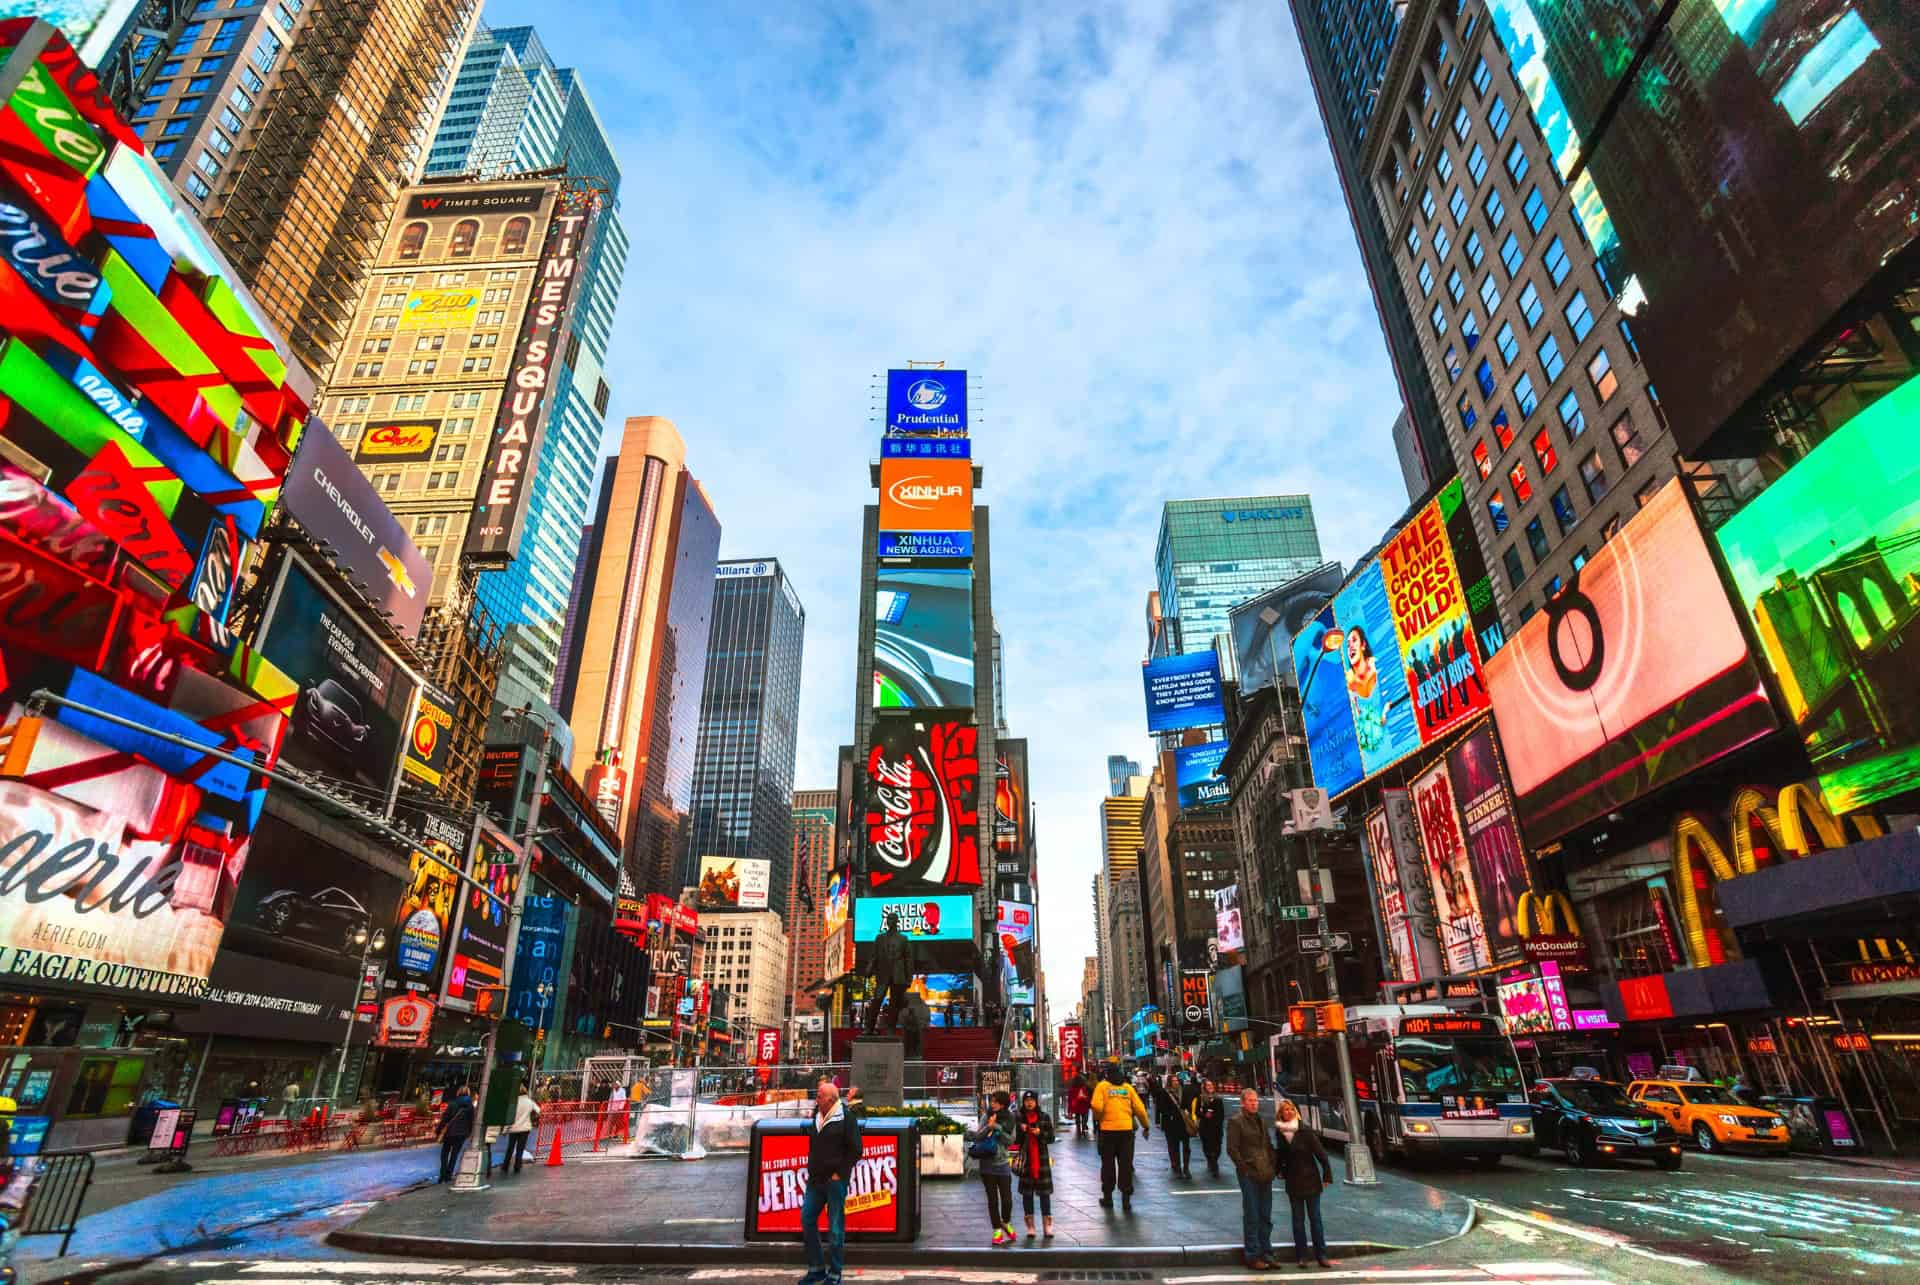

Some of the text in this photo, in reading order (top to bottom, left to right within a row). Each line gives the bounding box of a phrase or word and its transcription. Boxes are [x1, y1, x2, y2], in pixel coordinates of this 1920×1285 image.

[445, 198, 479, 207] TIMES
[484, 196, 531, 206] SQUARE
[0, 202, 98, 299] erie
[536, 215, 583, 326] TIMES
[80, 376, 144, 435] aerie
[897, 413, 959, 424] Prudential
[487, 341, 548, 505] SQUARE
[314, 467, 376, 545] CHEVROLET
[900, 486, 962, 500] XINHUA
[1238, 507, 1304, 521] BARCLAYS
[480, 527, 504, 536] NYC
[899, 535, 953, 546] XINHUA
[1380, 509, 1441, 575] THE
[886, 546, 965, 554] NEWS AGENCY
[714, 566, 750, 576] Allianz
[1390, 539, 1444, 597] CROWD
[1395, 559, 1451, 617] GOES
[1399, 576, 1459, 641] WILD!
[1417, 651, 1475, 709] JERSEY BOYS
[413, 715, 438, 761] Q
[486, 751, 519, 760] REUTERS
[876, 757, 913, 867] Coca-Cola
[1465, 792, 1505, 825] WINNER!
[426, 813, 440, 829] THE
[438, 818, 465, 843] BIGGEST
[0, 830, 183, 919] aerie
[882, 903, 927, 917] SEVEN
[32, 922, 107, 951] AERIE.COM
[1448, 912, 1483, 943] Annie
[10, 949, 208, 998] EAGLE OUTFITTERS
[646, 949, 681, 972] EY'S
[208, 991, 244, 1006] ALL-NEW
[244, 994, 261, 1008] 2014
[260, 996, 293, 1012] CORVETTE
[293, 1001, 322, 1015] STINGRAY
[762, 1032, 777, 1060] tkts
[1064, 1029, 1078, 1058] tkts
[774, 1158, 790, 1168] STORY
